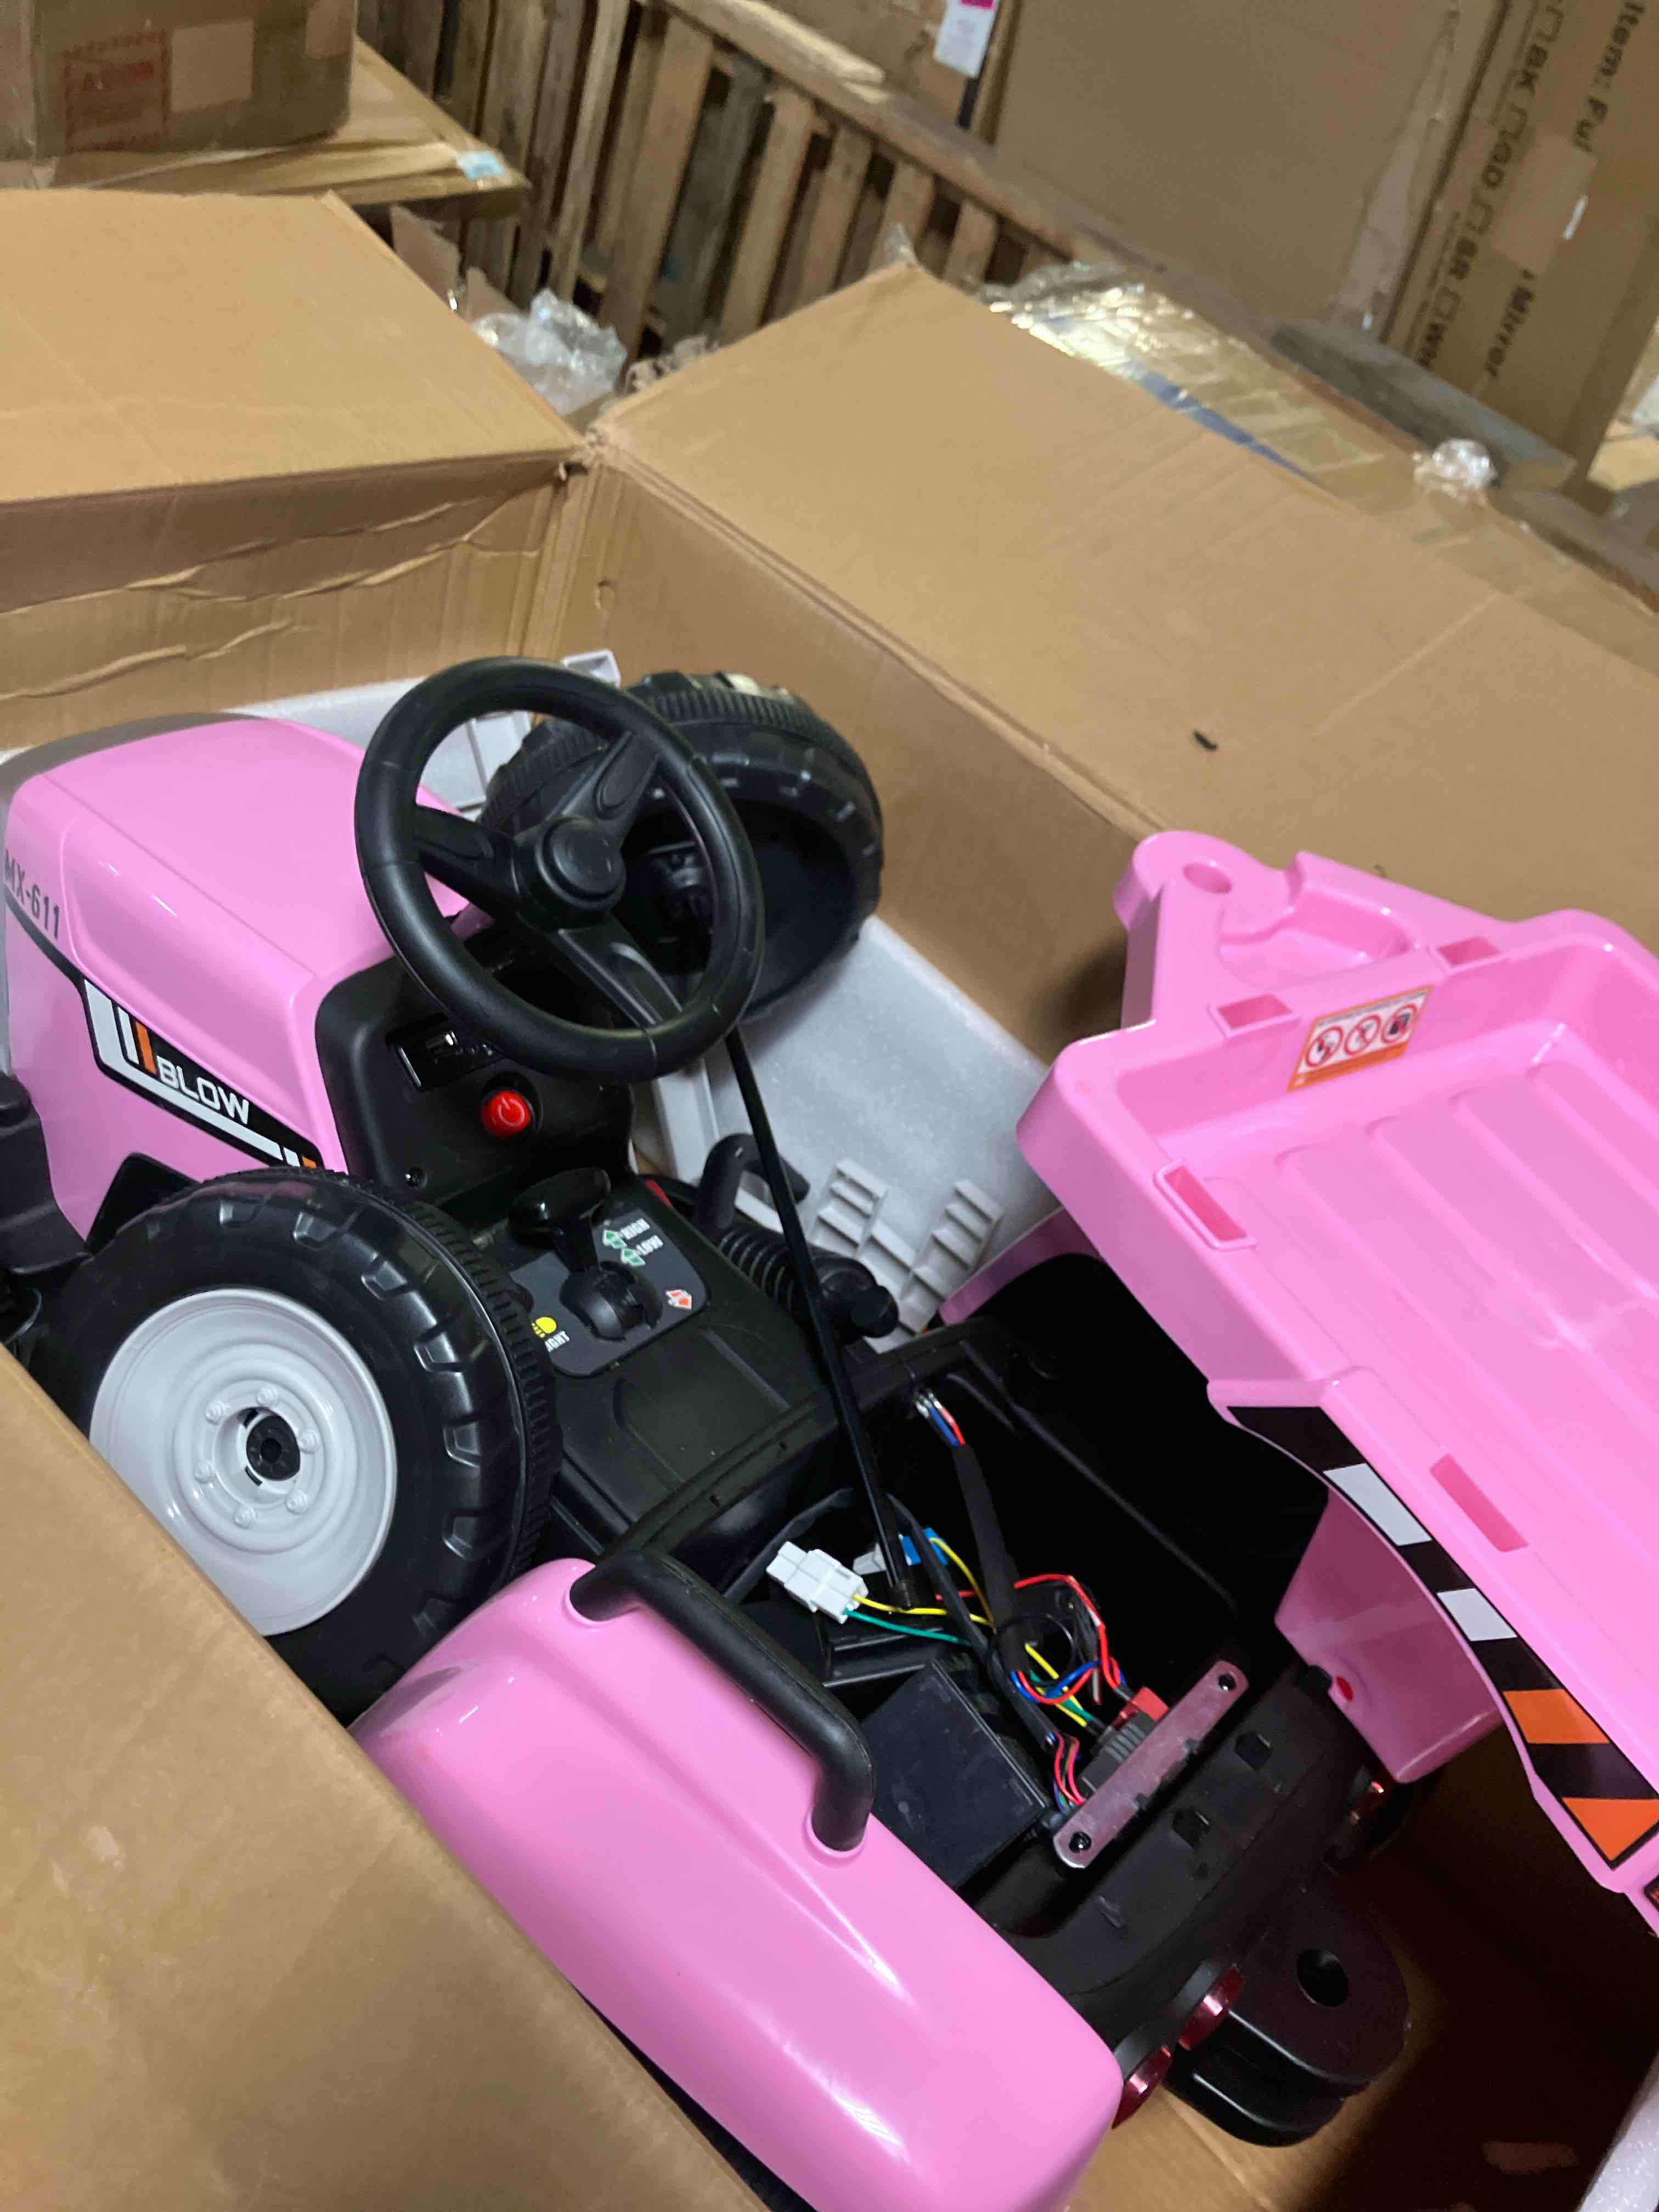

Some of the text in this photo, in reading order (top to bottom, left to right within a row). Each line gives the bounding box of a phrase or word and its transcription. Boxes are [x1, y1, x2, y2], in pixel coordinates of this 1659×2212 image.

[1483, 285, 1535, 377] Mirror
[4, 849, 59, 939] MX-611
[156, 1055, 249, 1125] BLOW
[545, 1330, 570, 1352] IGHT
